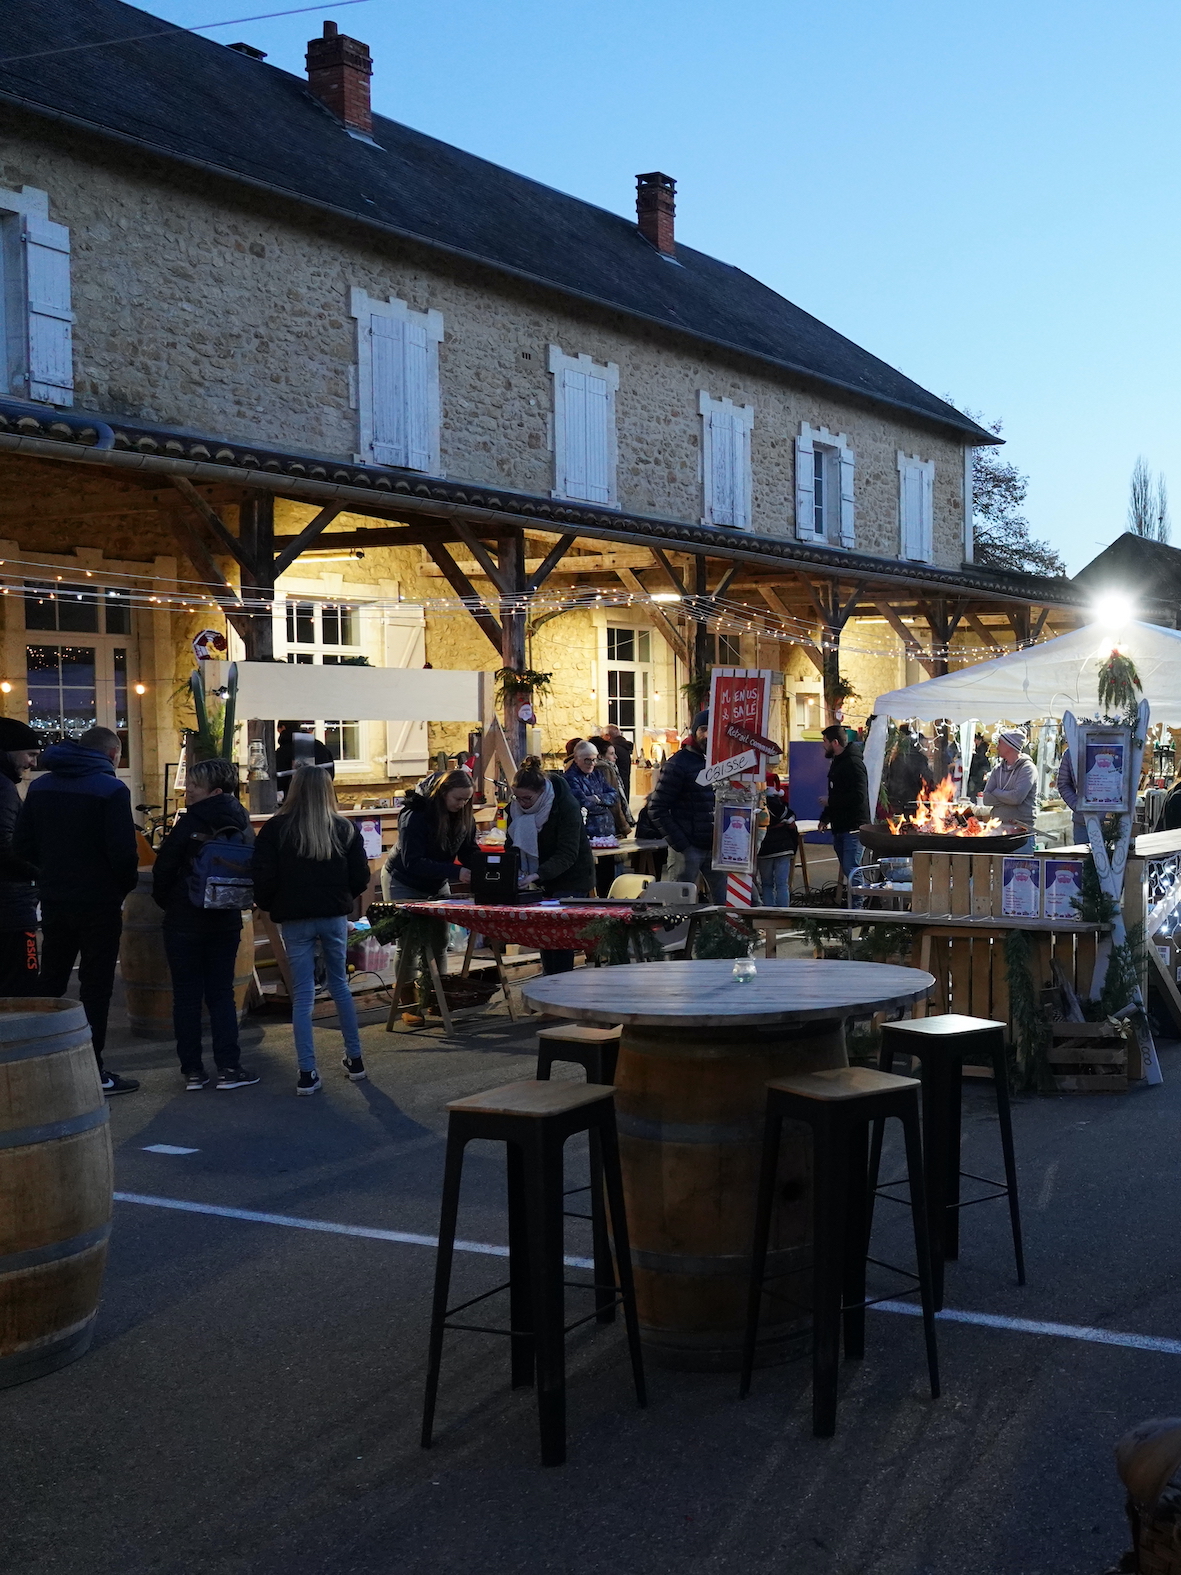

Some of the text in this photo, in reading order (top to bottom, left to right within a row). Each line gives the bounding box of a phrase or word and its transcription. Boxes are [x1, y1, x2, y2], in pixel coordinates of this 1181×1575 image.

[732, 702, 757, 718] SALÉ
[727, 726, 749, 743] Retrait
[27, 940, 37, 969] asics
